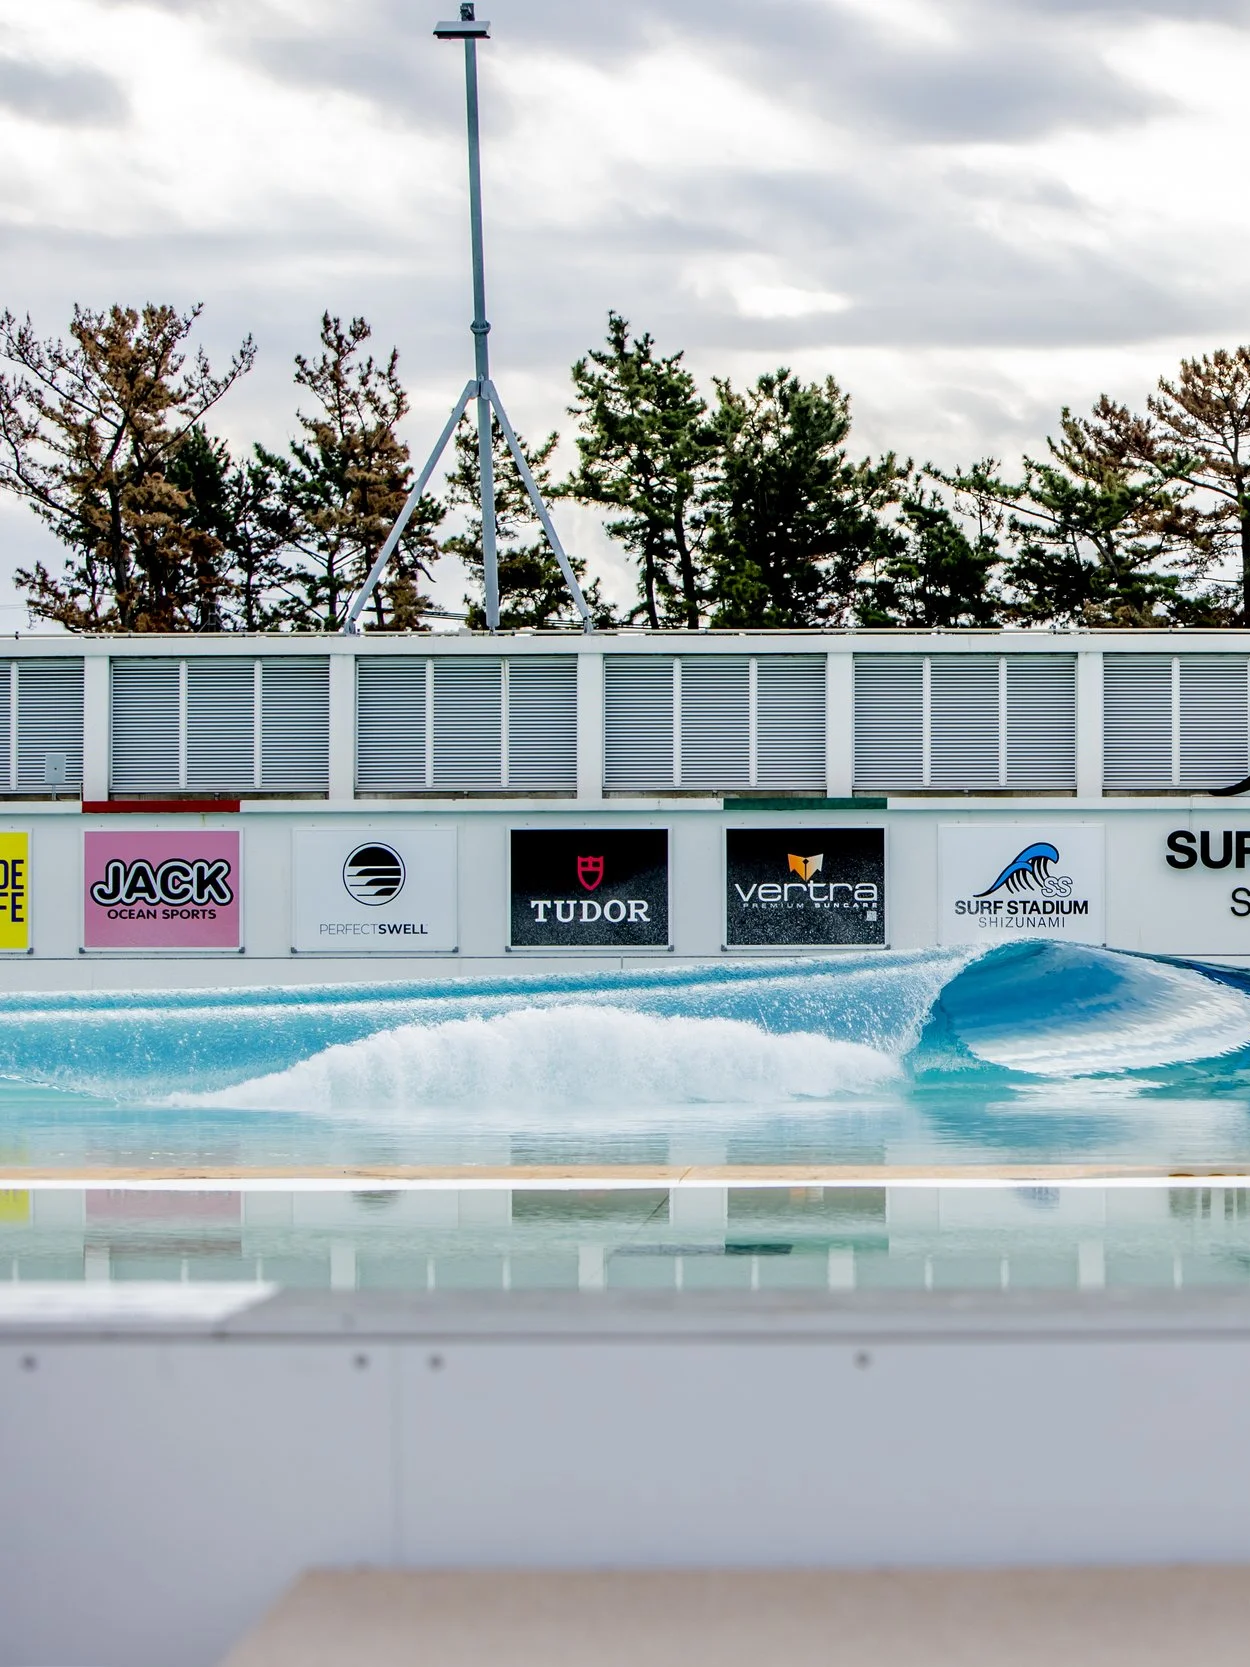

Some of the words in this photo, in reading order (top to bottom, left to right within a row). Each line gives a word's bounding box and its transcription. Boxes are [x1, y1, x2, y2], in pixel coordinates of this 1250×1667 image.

[90, 858, 234, 907] JACK
[734, 880, 878, 902] vertra
[107, 909, 157, 920] OCEAN
[162, 909, 217, 920] SPORTS
[530, 899, 651, 923] TUDOR
[954, 900, 1004, 915] SURF
[1006, 900, 1089, 915] STADIUM
[319, 923, 429, 935] PERFECTSWELL
[978, 916, 1065, 928] SHIZUNAMI
